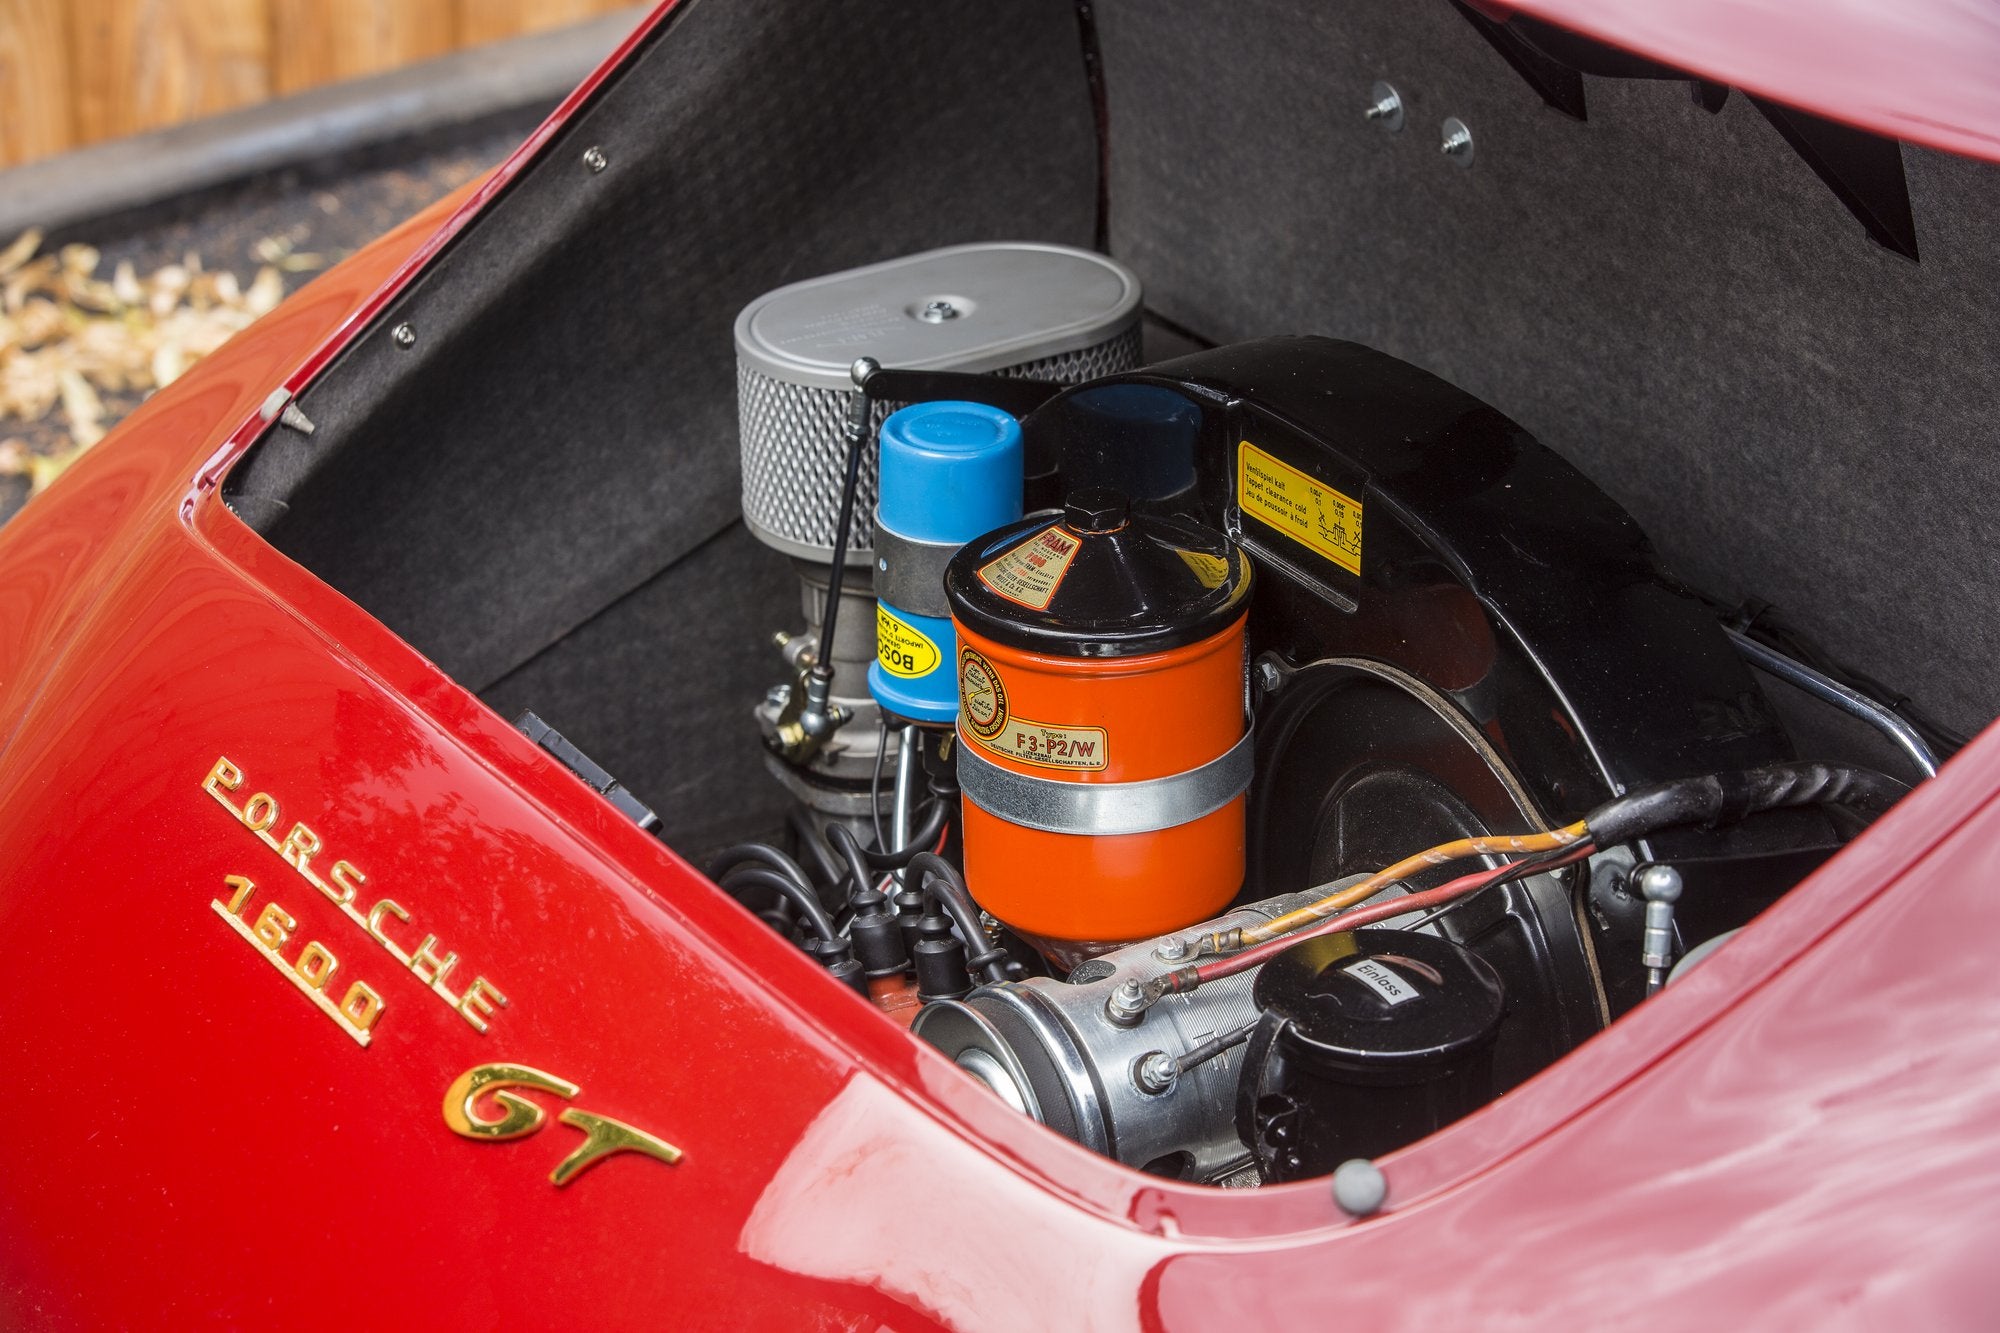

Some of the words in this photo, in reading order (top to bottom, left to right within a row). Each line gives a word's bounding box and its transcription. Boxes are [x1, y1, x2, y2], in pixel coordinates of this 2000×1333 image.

[1245, 474, 1263, 492] Tappet
[1265, 486, 1292, 507] clearance
[1295, 502, 1307, 515] cold
[1245, 487, 1255, 499] Jeu
[1256, 493, 1263, 504] de
[1264, 499, 1288, 519] poussoir
[1294, 515, 1308, 528] froid
[1041, 531, 1075, 557] FRAM
[893, 623, 899, 633] 6
[878, 638, 914, 672] BOSC
[982, 663, 996, 680] WENN
[992, 680, 1002, 693] DAS
[990, 742, 1013, 755] DEUTSCHE
[1040, 728, 1067, 739] Type:
[202, 756, 509, 1034] PORSCHE
[211, 874, 387, 1048] 1600
[1356, 964, 1402, 997] Einlass
[442, 1062, 684, 1186] GT
